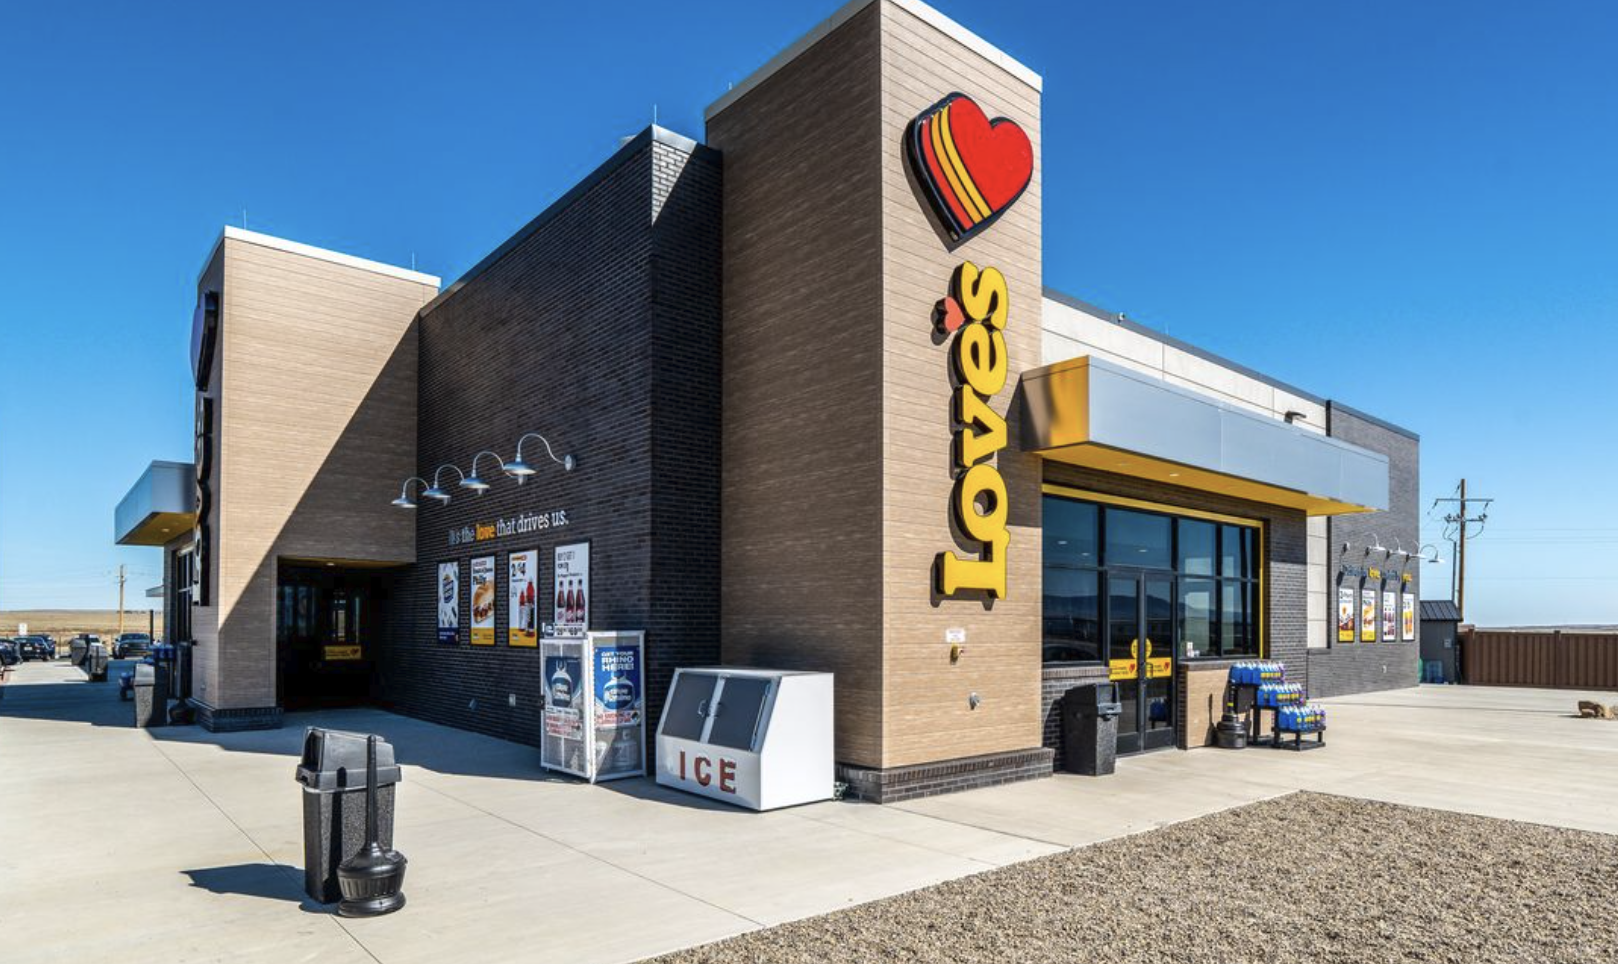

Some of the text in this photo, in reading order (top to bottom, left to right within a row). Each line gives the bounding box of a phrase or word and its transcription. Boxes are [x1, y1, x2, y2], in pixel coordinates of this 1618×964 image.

[461, 526, 475, 543] the
[476, 523, 496, 540] love
[497, 518, 516, 537] that
[517, 512, 550, 533] drives
[552, 509, 569, 527] us.
[601, 656, 634, 664] RHINO
[601, 663, 634, 672] HERE!
[679, 751, 736, 794] ICE
